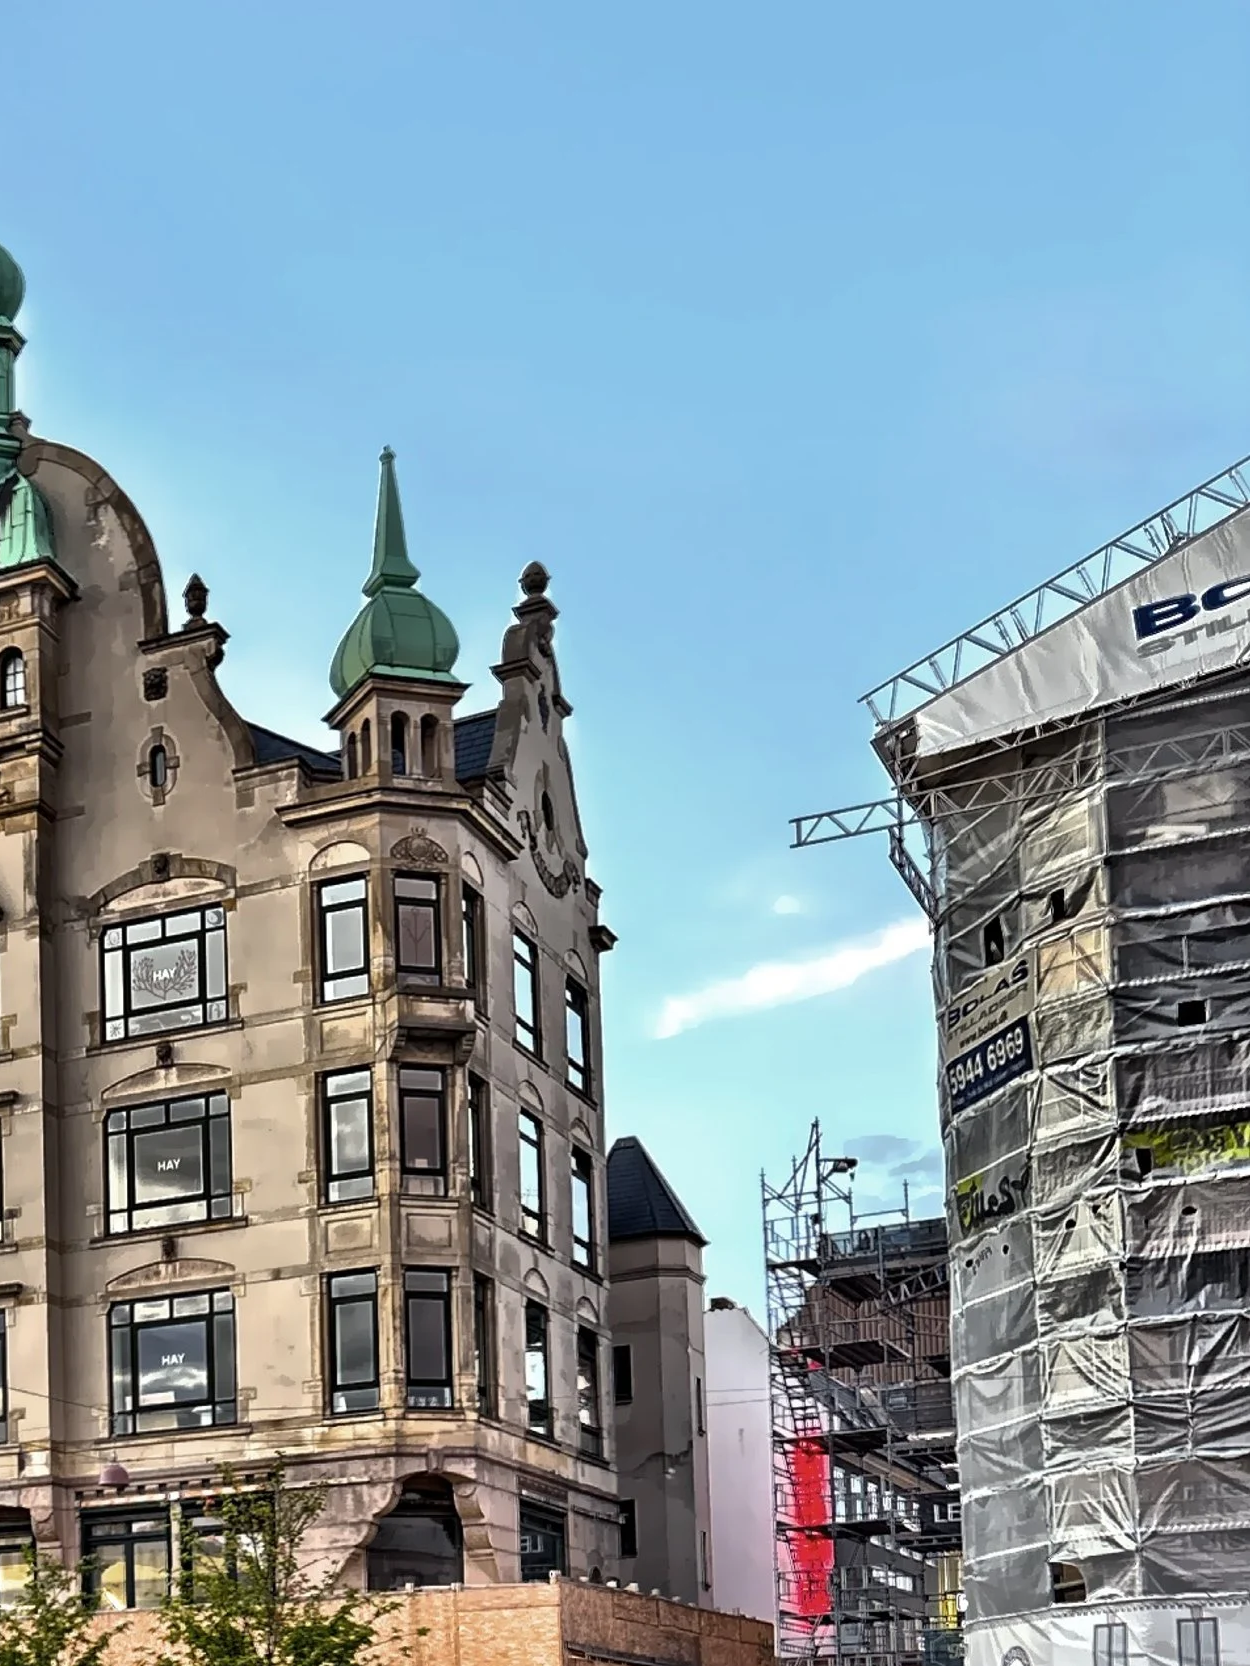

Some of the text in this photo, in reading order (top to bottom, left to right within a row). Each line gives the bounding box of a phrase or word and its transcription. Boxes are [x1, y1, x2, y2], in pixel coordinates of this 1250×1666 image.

[1136, 608, 1250, 659] STIL
[152, 967, 177, 982] HAY
[947, 959, 1029, 1032] BOLAS
[949, 1052, 984, 1096] 5944
[986, 1026, 1024, 1072] 6969
[157, 1158, 181, 1172] HAY
[161, 1352, 185, 1366] HAY
